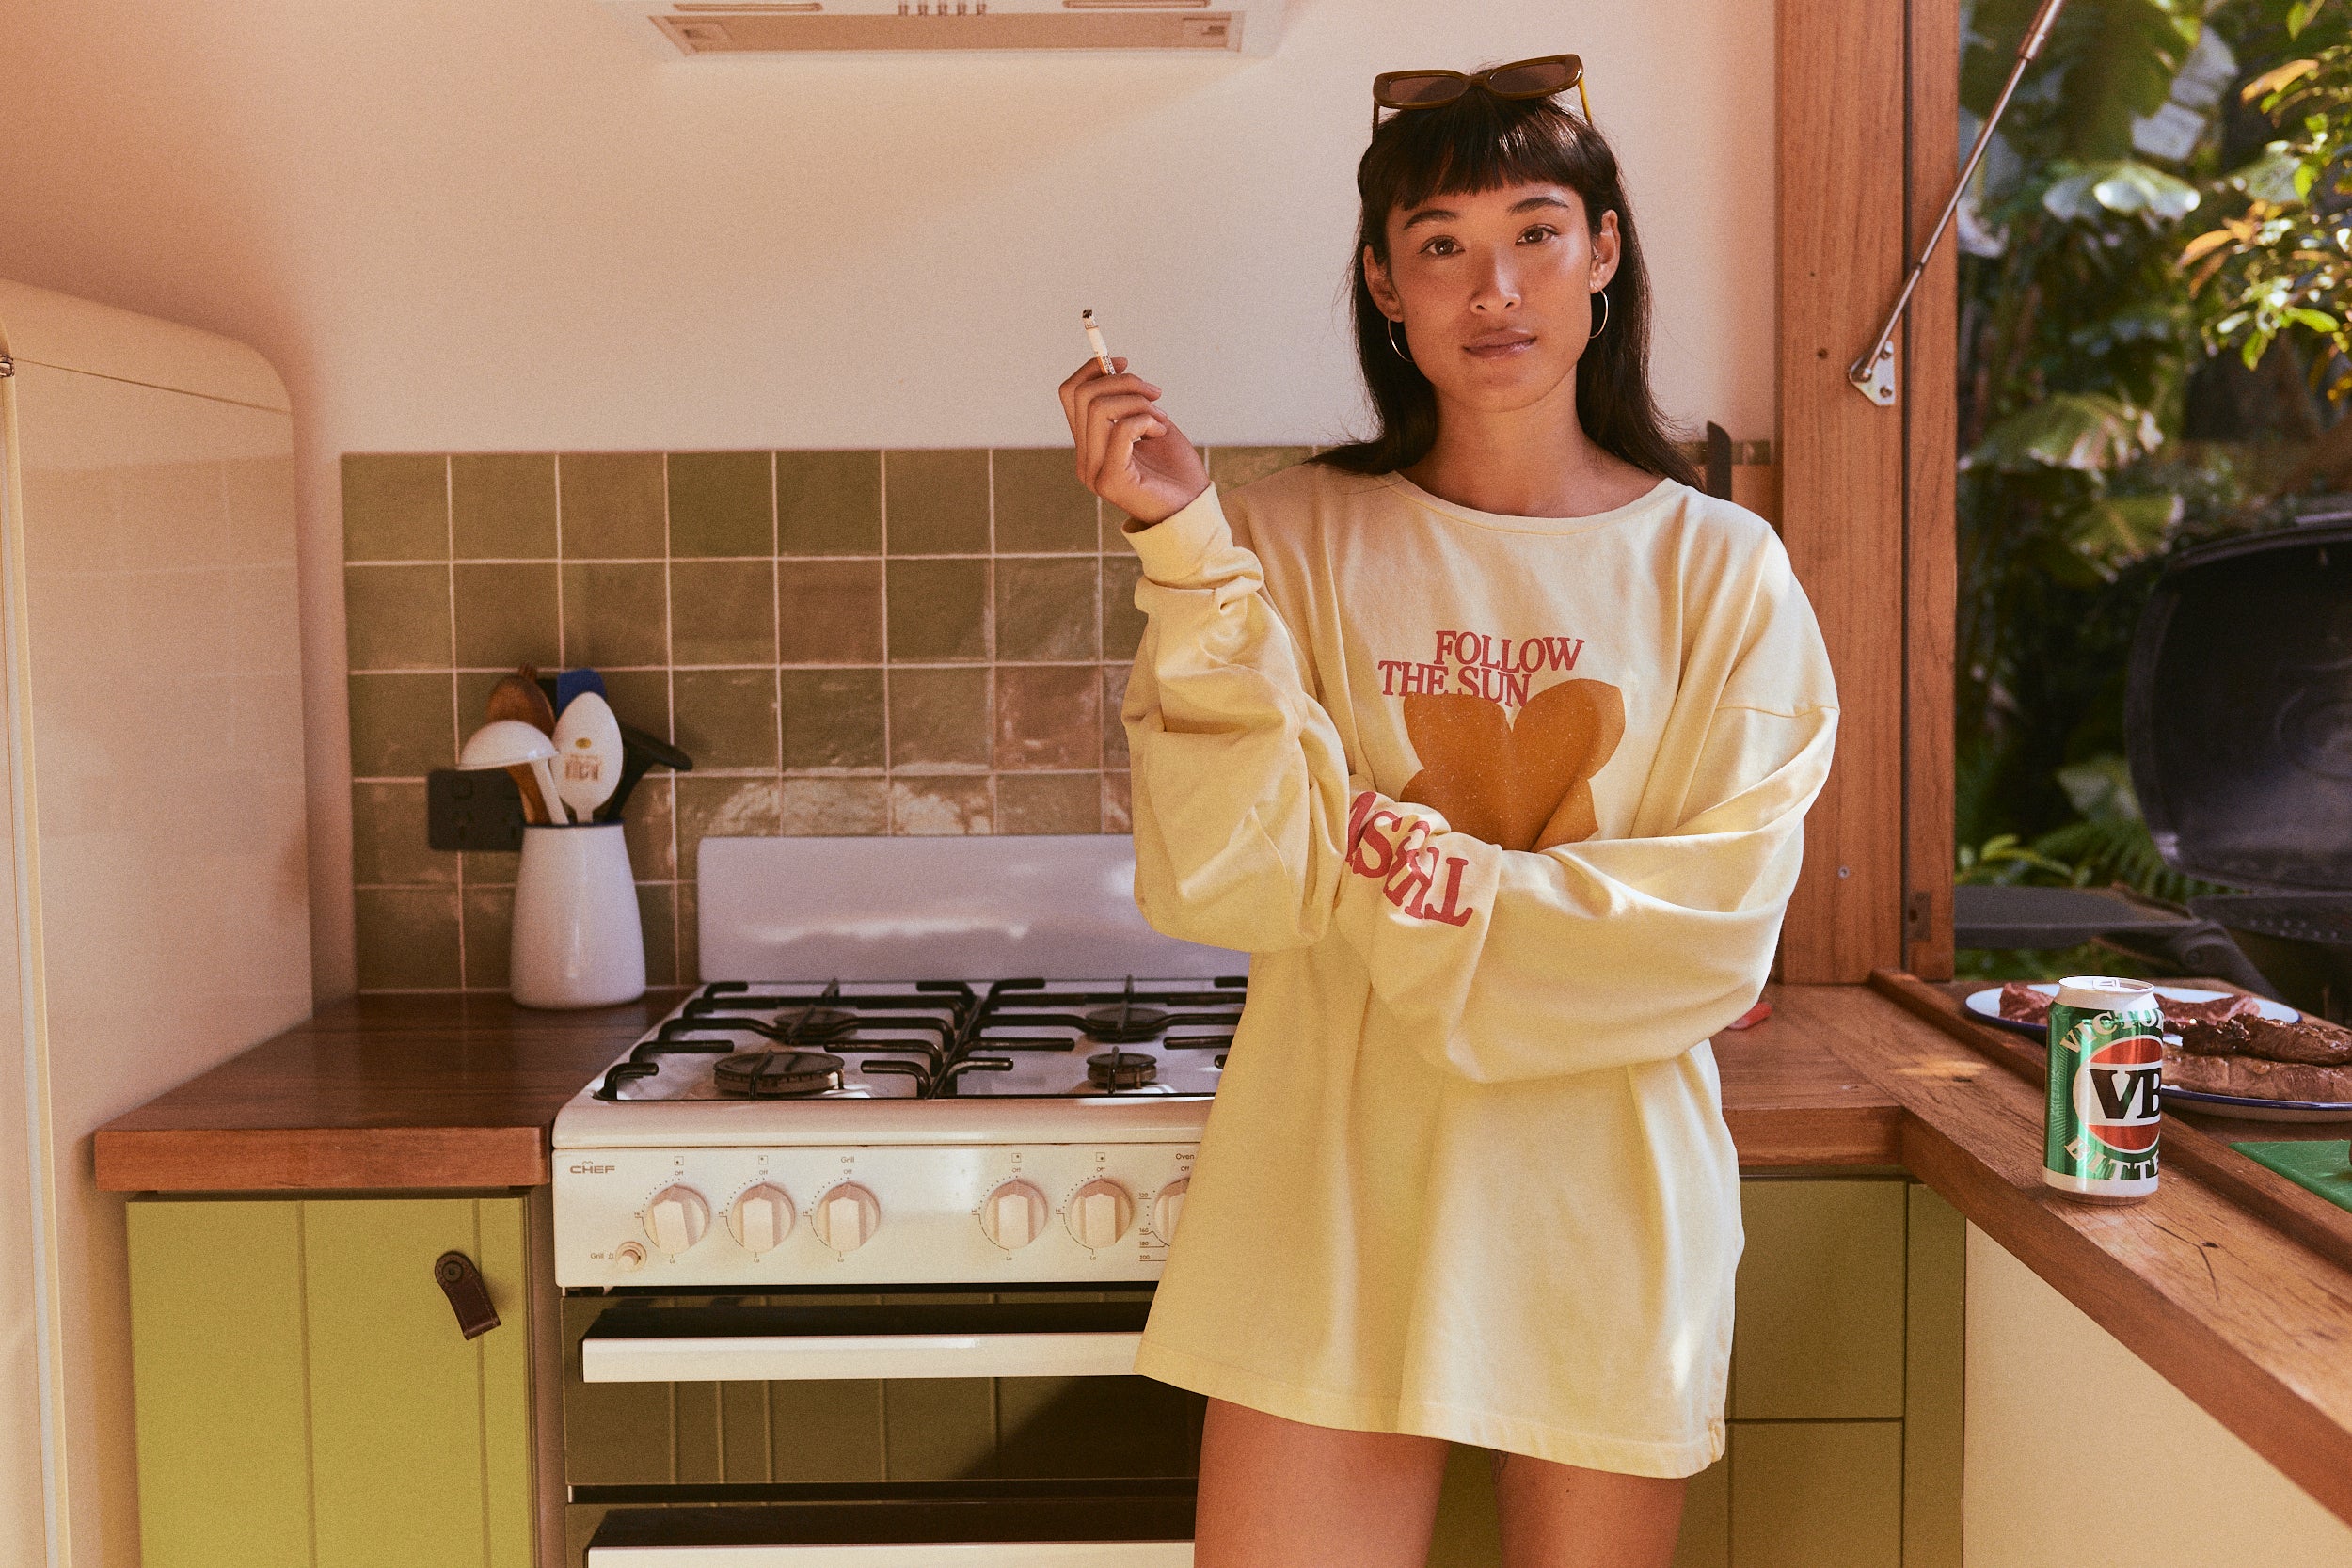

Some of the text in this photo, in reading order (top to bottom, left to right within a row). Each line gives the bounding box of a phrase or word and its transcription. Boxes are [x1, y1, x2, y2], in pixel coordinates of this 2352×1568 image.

[1434, 630, 1584, 673] FOLLOW
[1378, 660, 1532, 707] THE SUN
[2090, 1068, 2162, 1120] VB
[570, 1164, 615, 1174] CHEF
[840, 1155, 855, 1164] Grill
